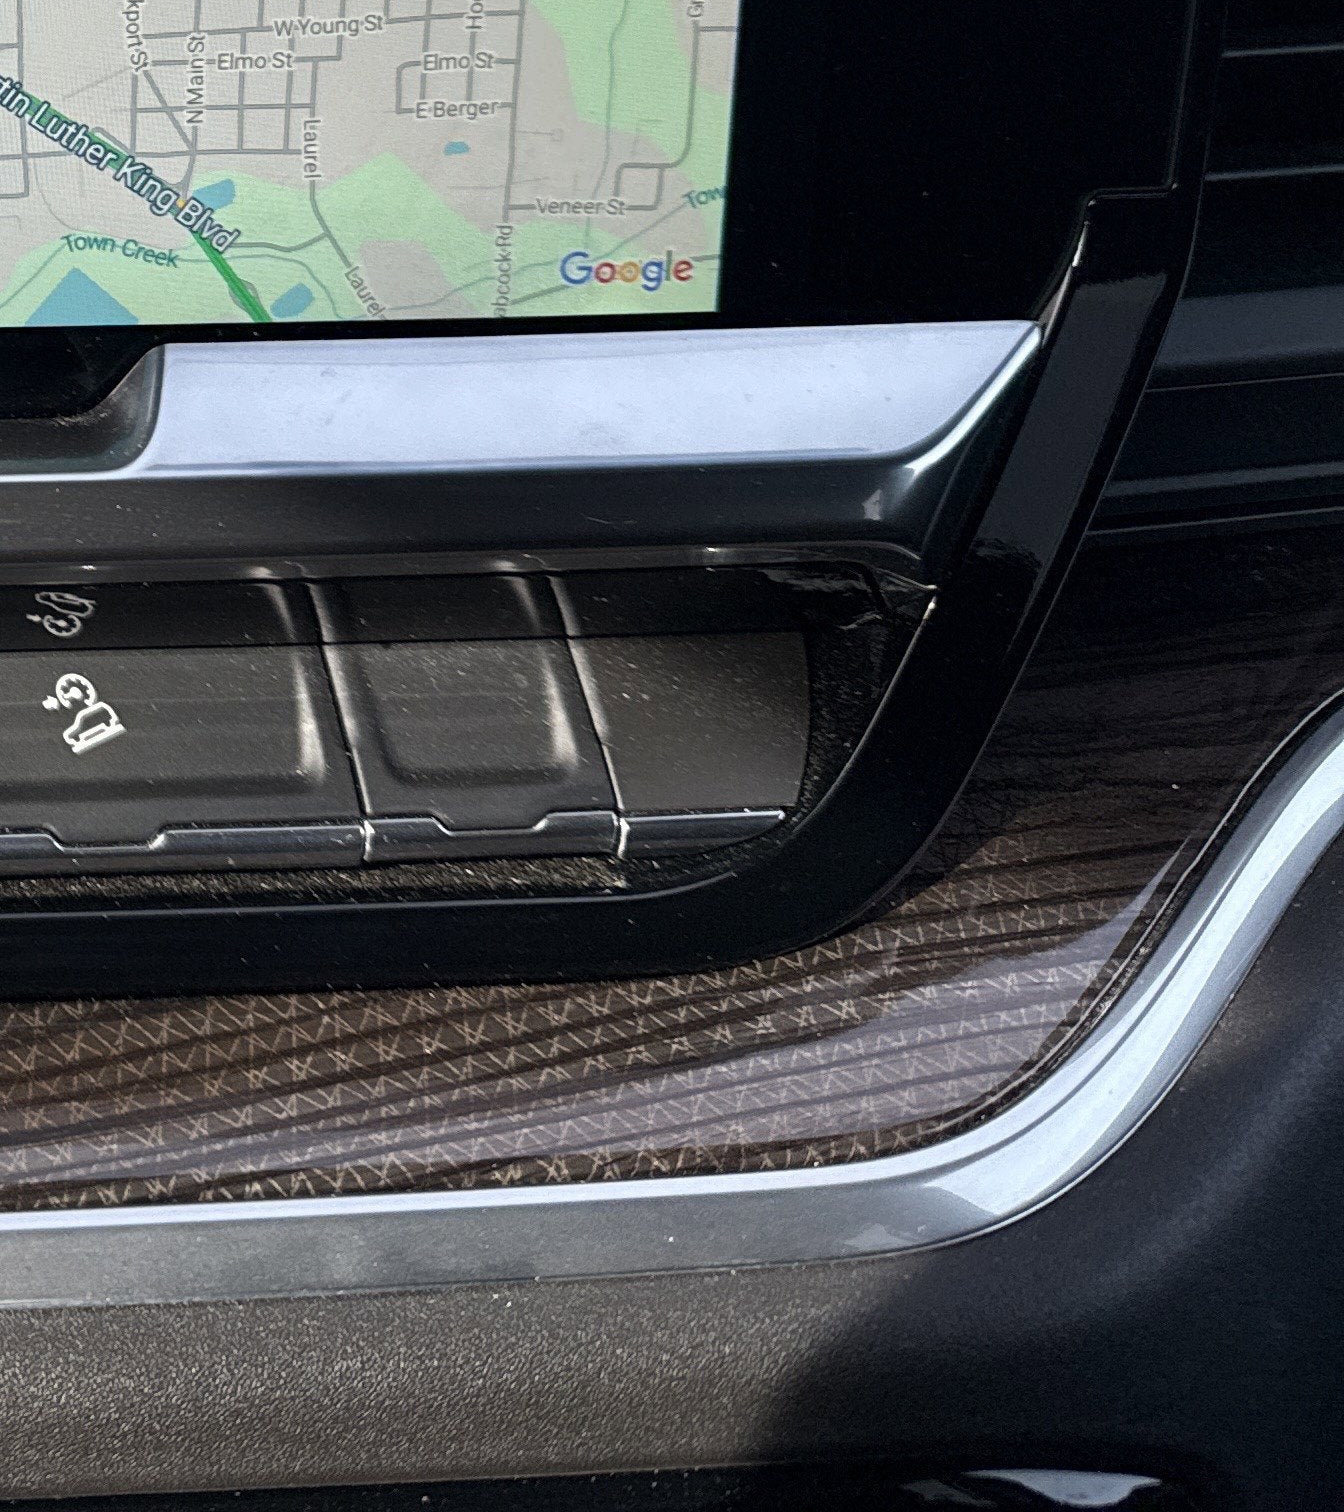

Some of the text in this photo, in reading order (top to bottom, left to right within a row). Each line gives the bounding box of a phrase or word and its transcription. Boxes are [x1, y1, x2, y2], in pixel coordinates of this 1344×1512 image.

[274, 15, 384, 38] W Young St
[130, 50, 148, 73] St
[217, 52, 293, 71] Elmo St
[423, 52, 494, 70] Elmo St
[185, 36, 207, 125] N Main St
[416, 100, 499, 120] E Berger
[303, 119, 322, 179] Laurel
[31, 100, 119, 170] Luther
[113, 153, 181, 218] King
[174, 196, 240, 254] Blvd
[536, 199, 627, 217] Veneer St
[495, 224, 514, 248] Rd
[63, 233, 180, 269] Town Creek
[560, 249, 695, 292] Google
[344, 265, 386, 320] Laurel
